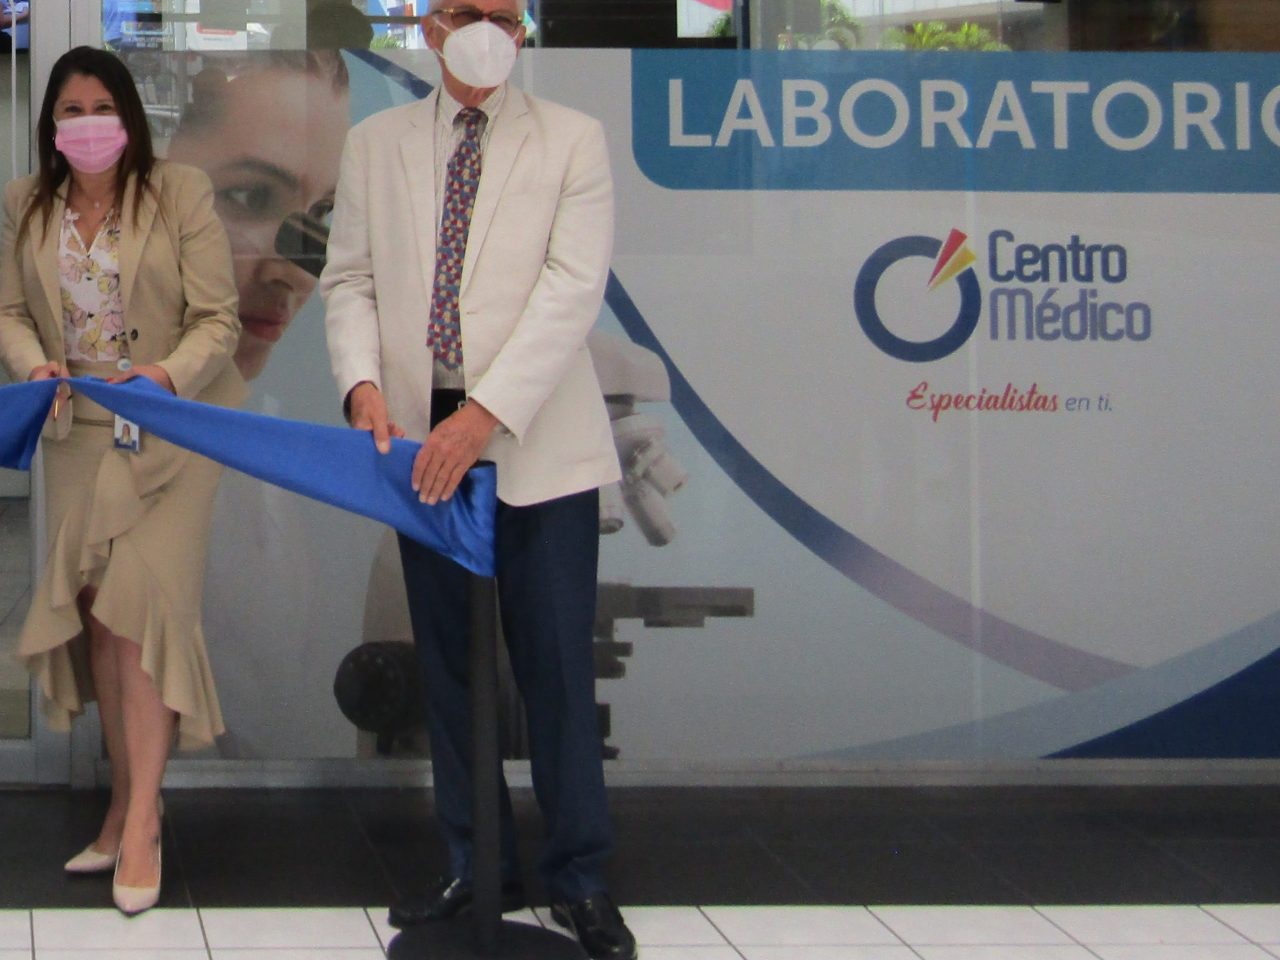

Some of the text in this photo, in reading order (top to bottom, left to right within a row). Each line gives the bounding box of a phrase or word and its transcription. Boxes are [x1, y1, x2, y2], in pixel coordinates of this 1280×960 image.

[668, 78, 1280, 151] LABORATORI
[988, 229, 1128, 283] Centro
[989, 287, 1152, 341] Médico
[906, 381, 1059, 422] Especialistas
[1065, 396, 1090, 411] en
